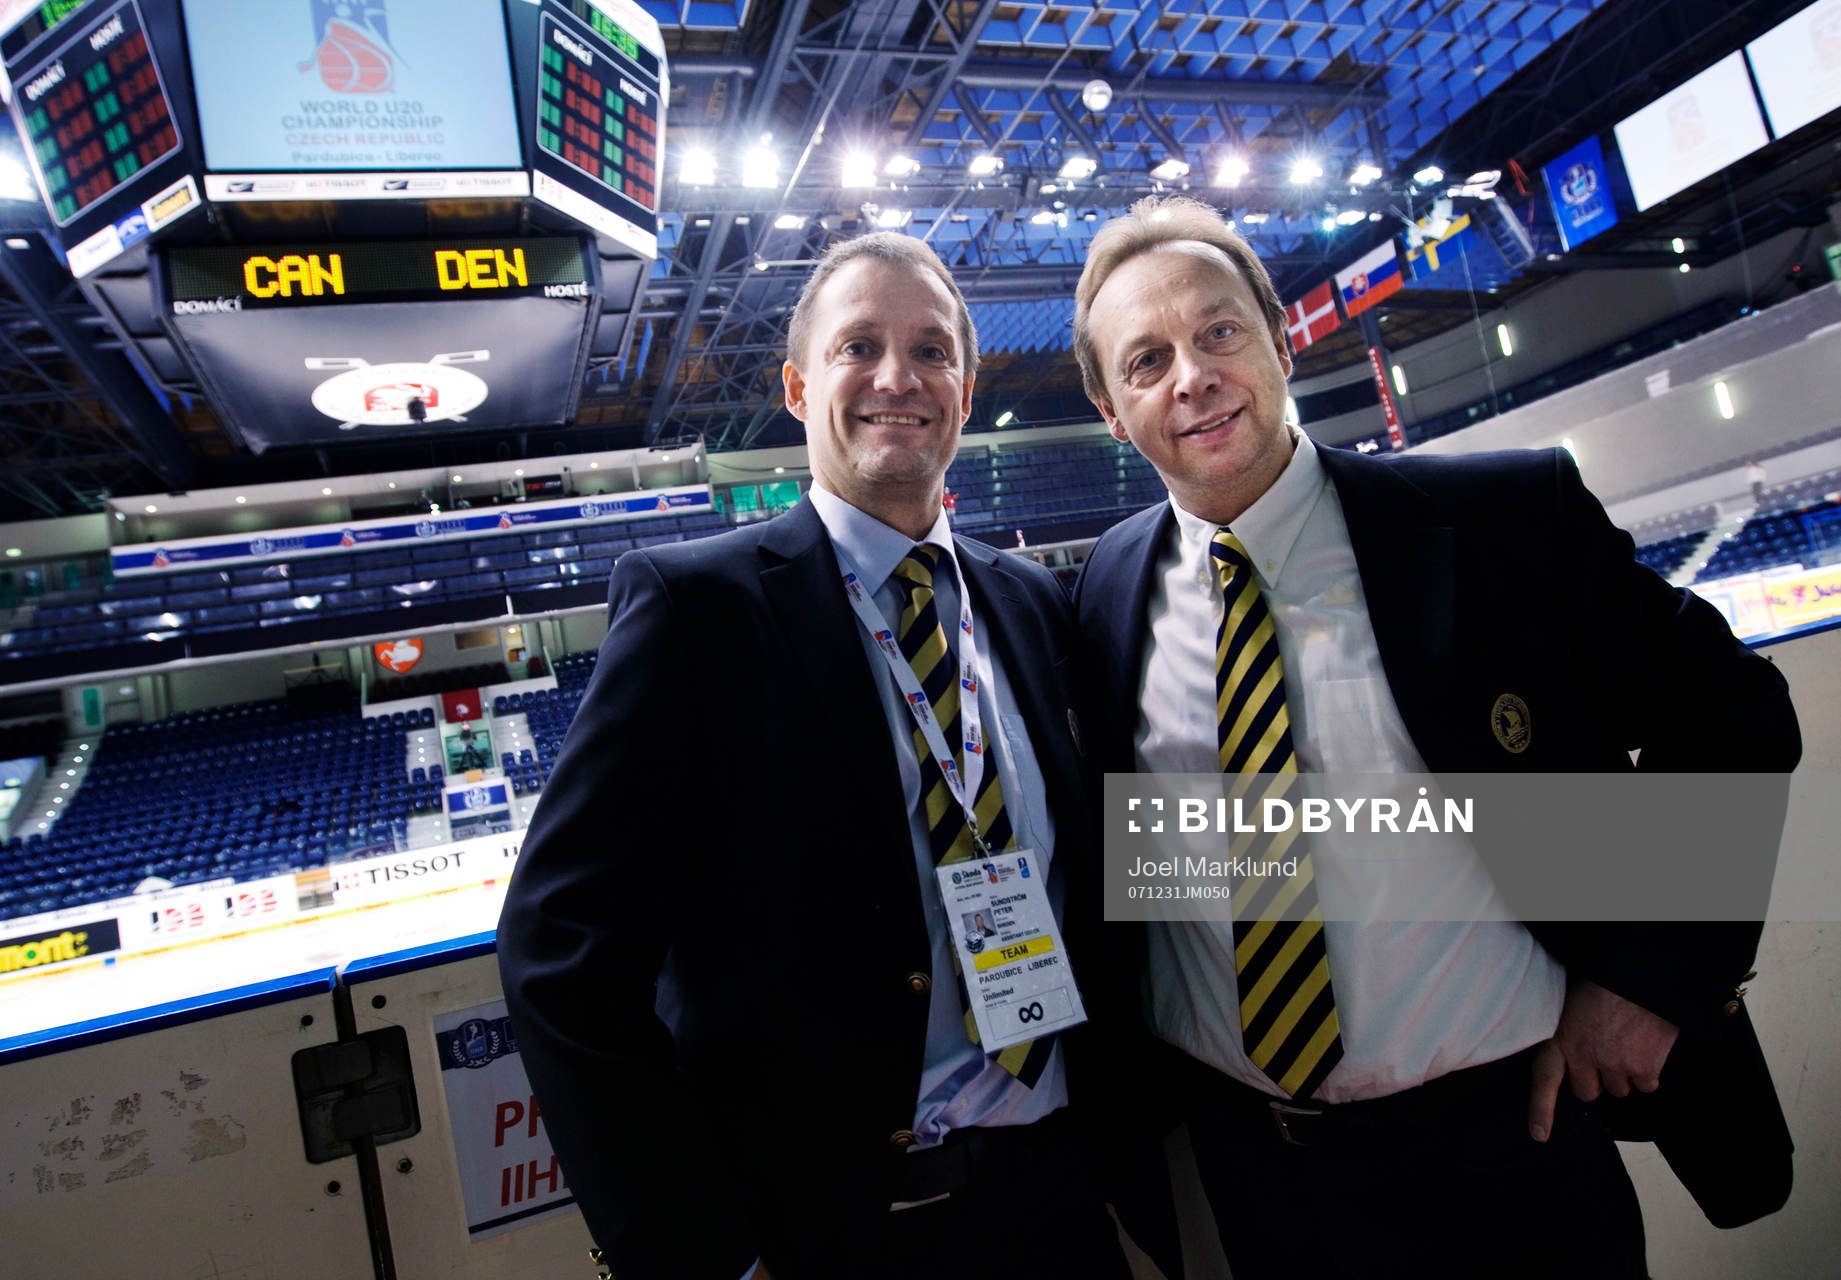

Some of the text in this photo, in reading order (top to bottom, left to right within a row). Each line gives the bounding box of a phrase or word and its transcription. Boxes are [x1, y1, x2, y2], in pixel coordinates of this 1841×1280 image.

[300, 99, 423, 115] WORLD U20
[281, 115, 444, 130] CHAMPIONSHIP
[285, 132, 446, 146] CZECH REPUBLIC
[291, 151, 375, 163] Pardubice
[385, 151, 441, 162] Liberec
[243, 248, 529, 298] CAN DEN
[544, 281, 590, 298] HOSTÉ
[173, 299, 243, 315] DOMÁCÍ
[363, 851, 466, 885] TISSOT
[993, 905, 1013, 916] PETER
[1000, 944, 1029, 960] TEAM
[978, 956, 1058, 985] PARDUBICE LIBEREC
[983, 987, 1014, 1002] Unlimited
[501, 1154, 570, 1208] IIH
